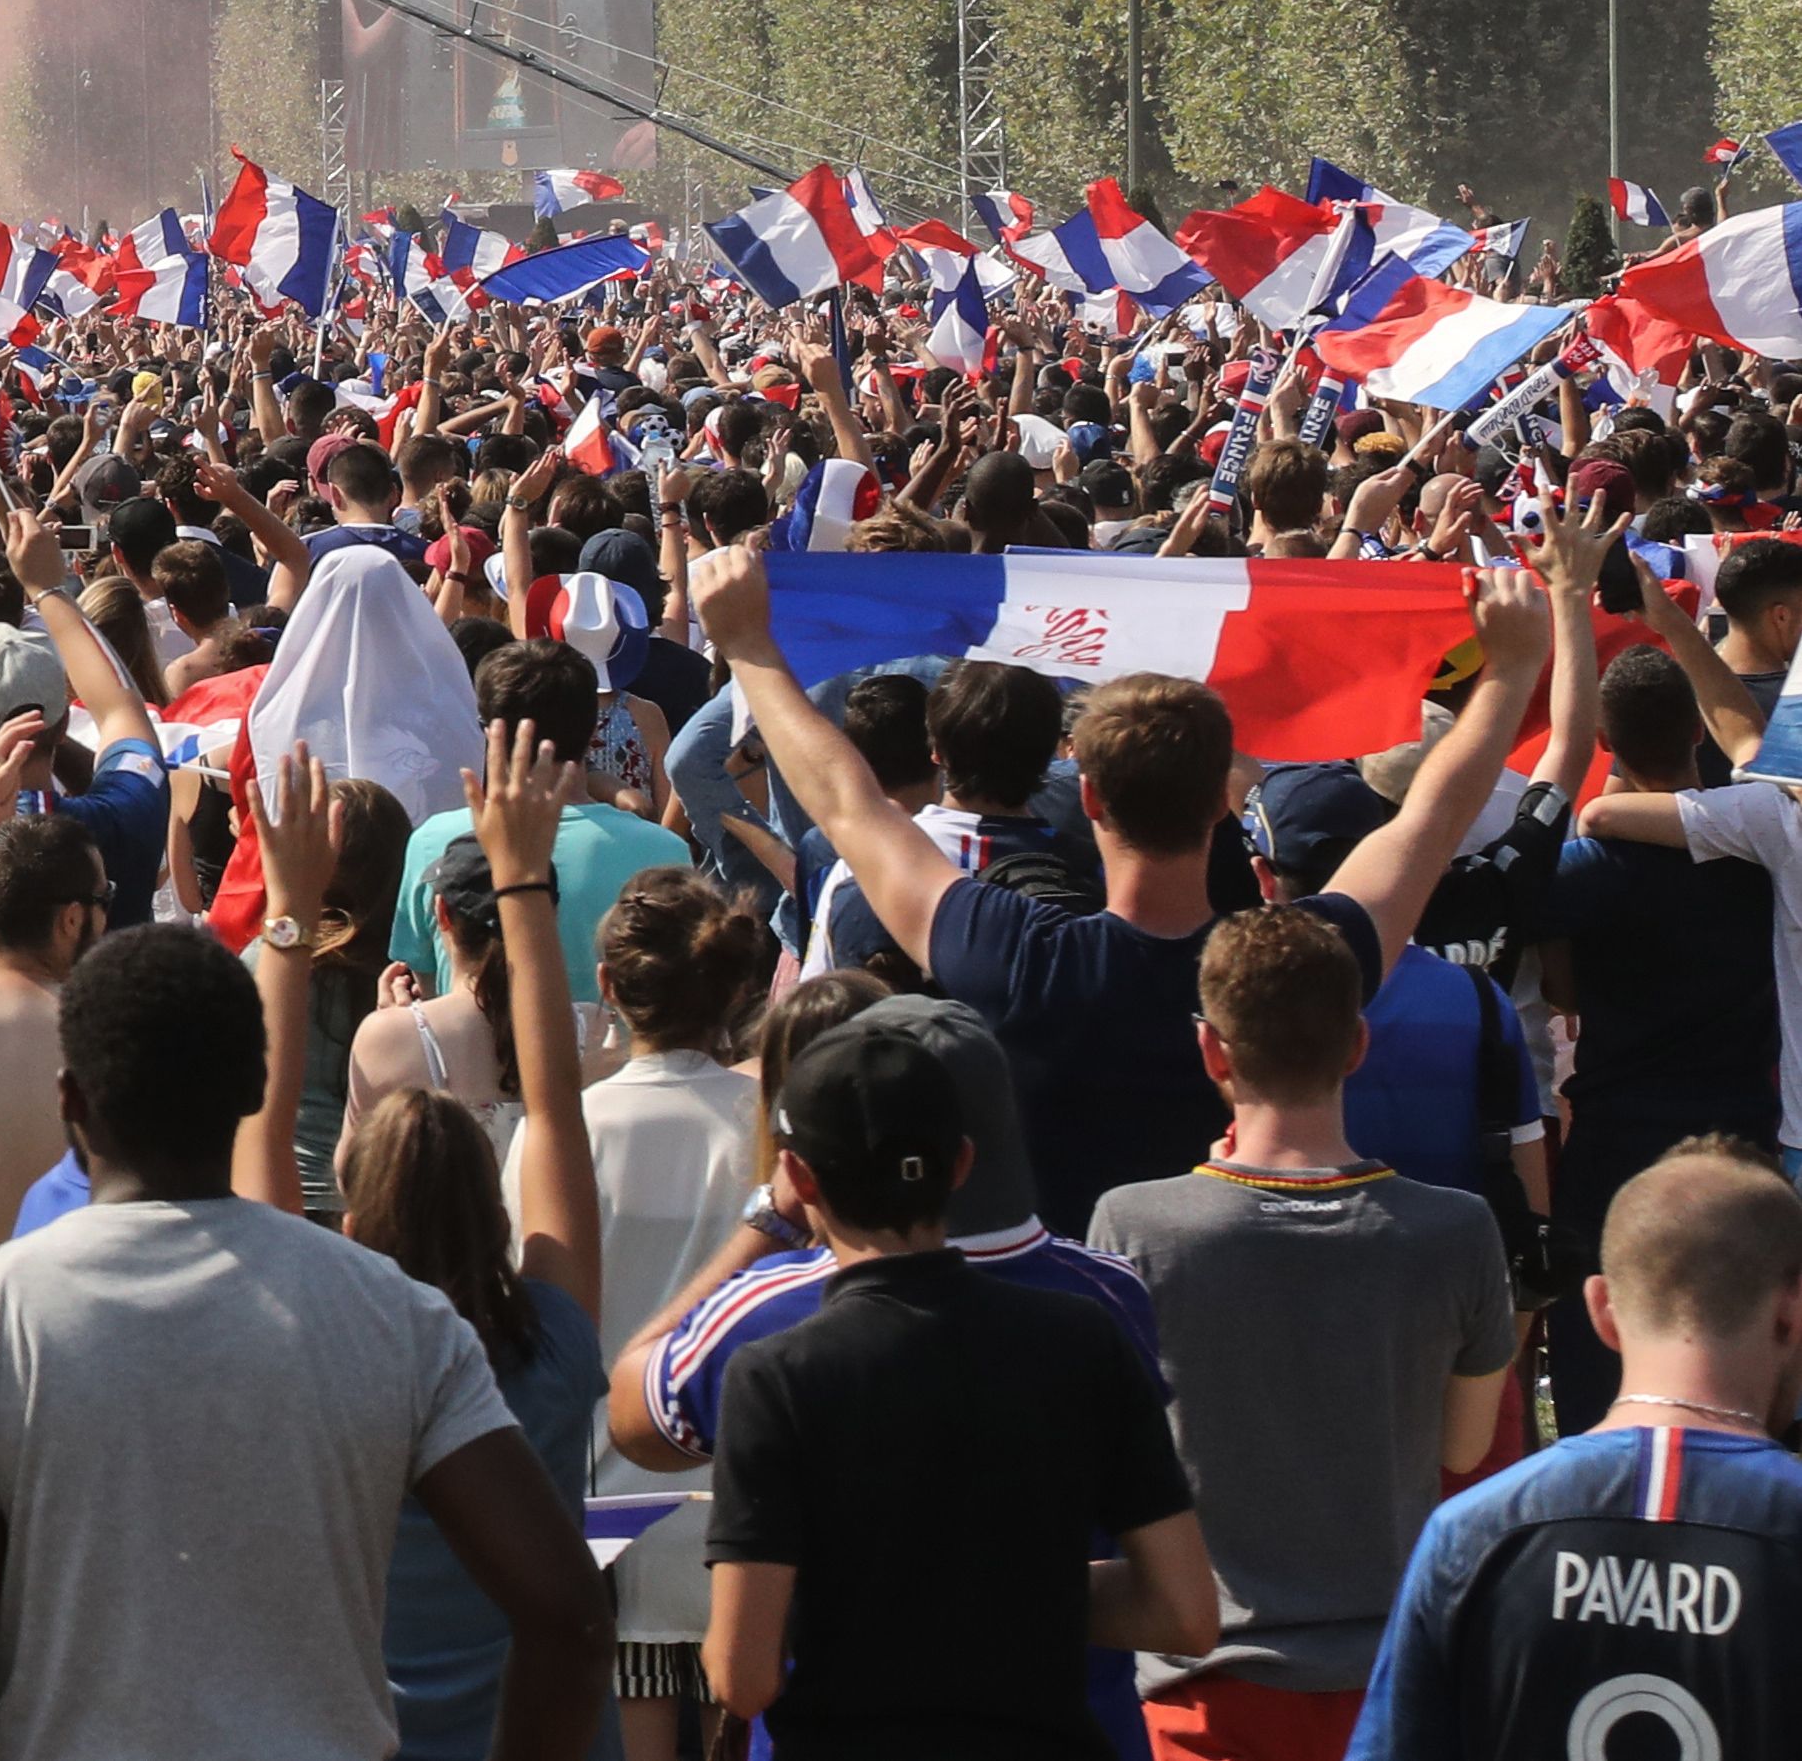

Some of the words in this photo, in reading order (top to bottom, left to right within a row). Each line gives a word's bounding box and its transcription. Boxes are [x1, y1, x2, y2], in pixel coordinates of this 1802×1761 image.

[1219, 410, 1257, 485] FRANCE
[1298, 396, 1331, 445] ANCE
[1552, 1550, 1742, 1636] PAVARD
